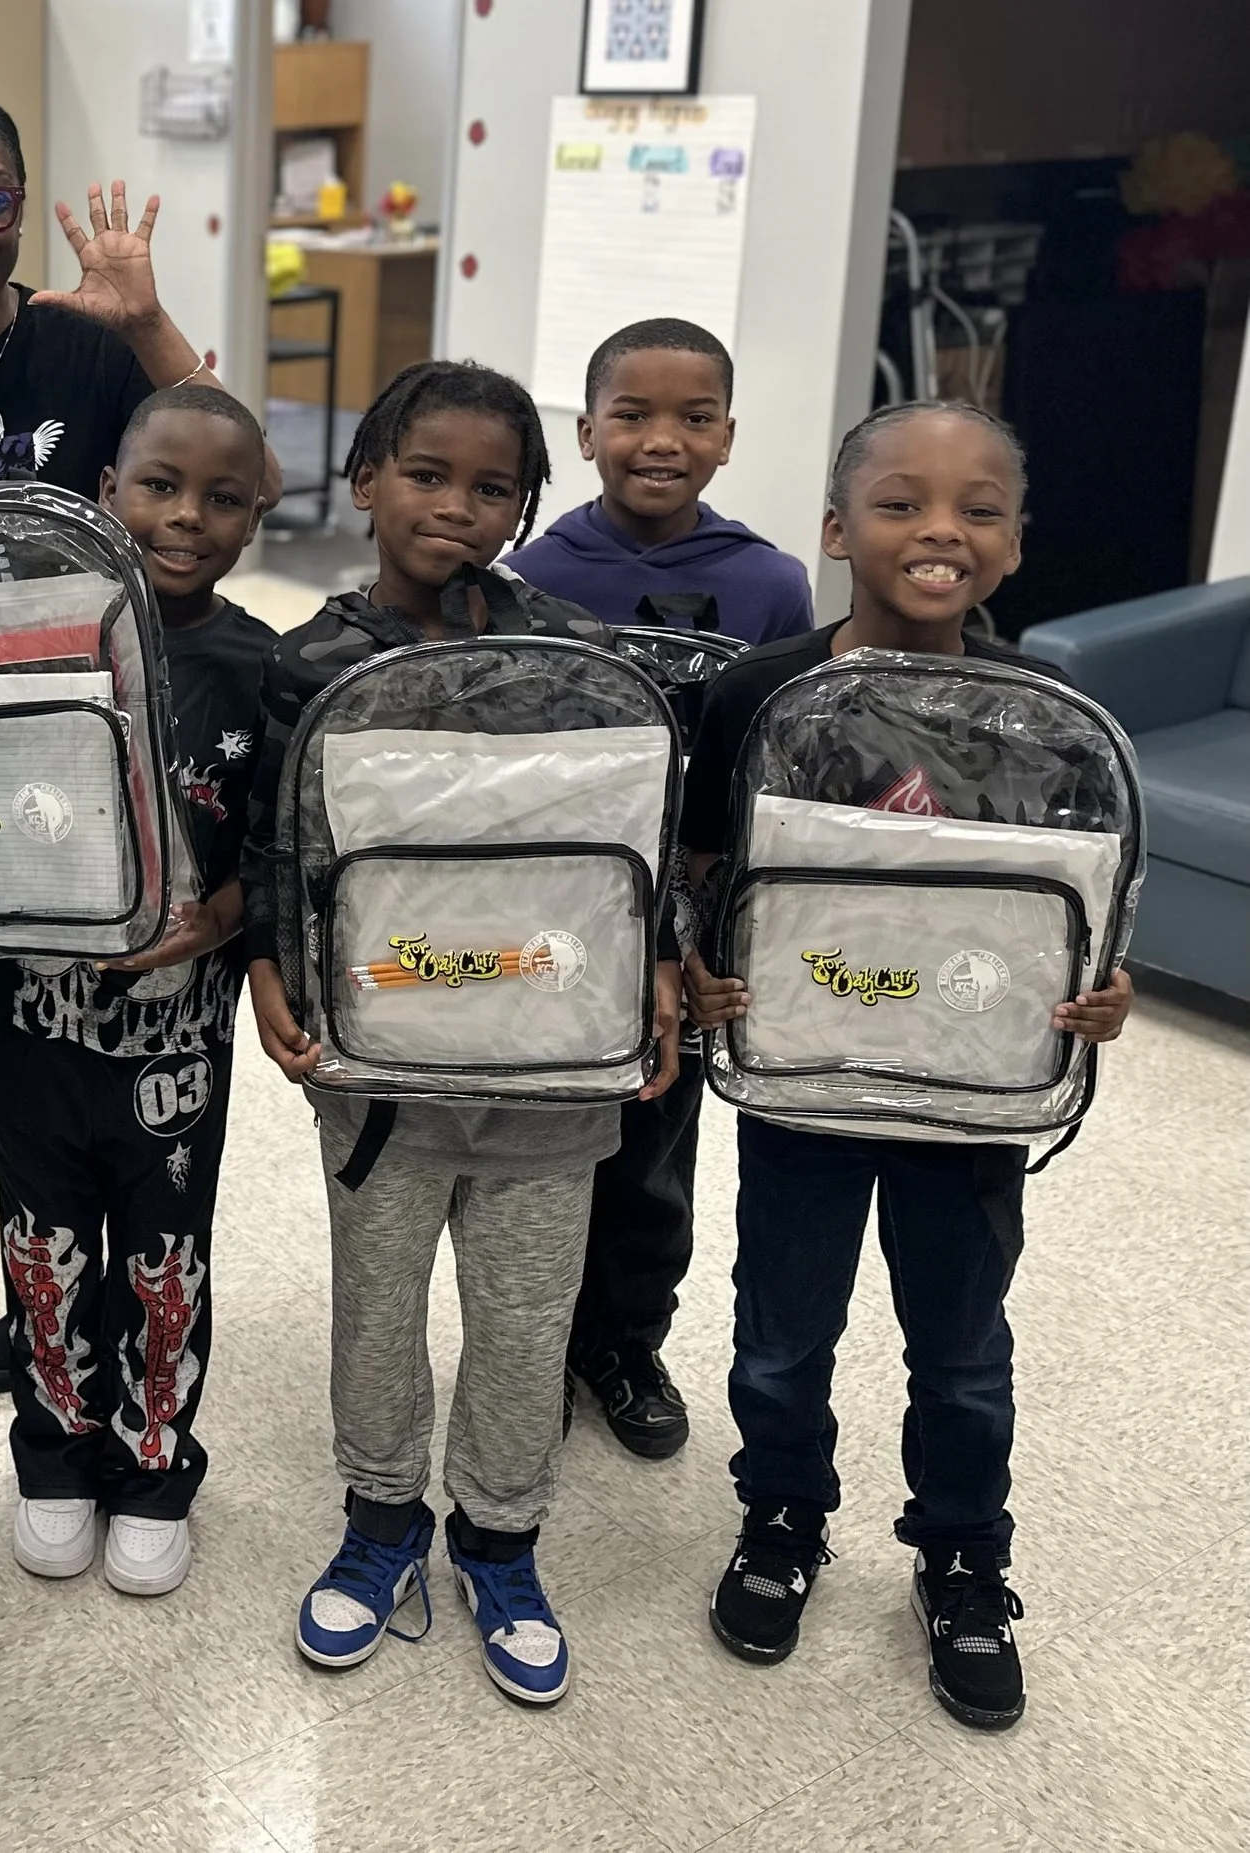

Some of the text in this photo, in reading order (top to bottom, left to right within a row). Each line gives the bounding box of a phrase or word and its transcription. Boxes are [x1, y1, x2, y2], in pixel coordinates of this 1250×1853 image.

[388, 932, 431, 971] For
[801, 948, 846, 985] For
[138, 1061, 208, 1126] 03
